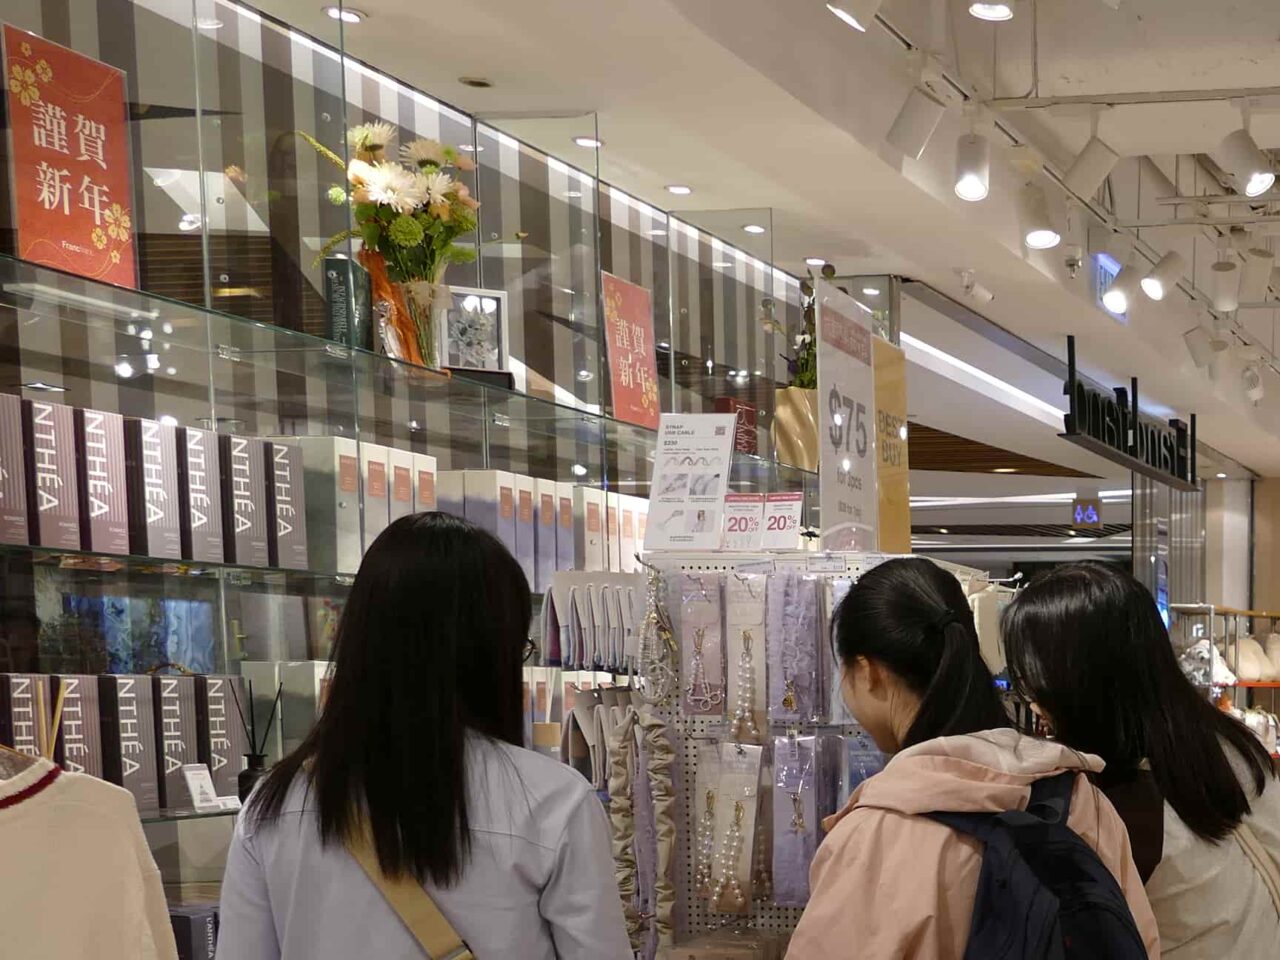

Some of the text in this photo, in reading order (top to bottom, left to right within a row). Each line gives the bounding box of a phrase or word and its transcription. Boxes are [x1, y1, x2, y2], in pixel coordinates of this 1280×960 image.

[32, 100, 108, 171] 謹賀
[35, 161, 111, 226] 新年
[828, 383, 868, 459] $75
